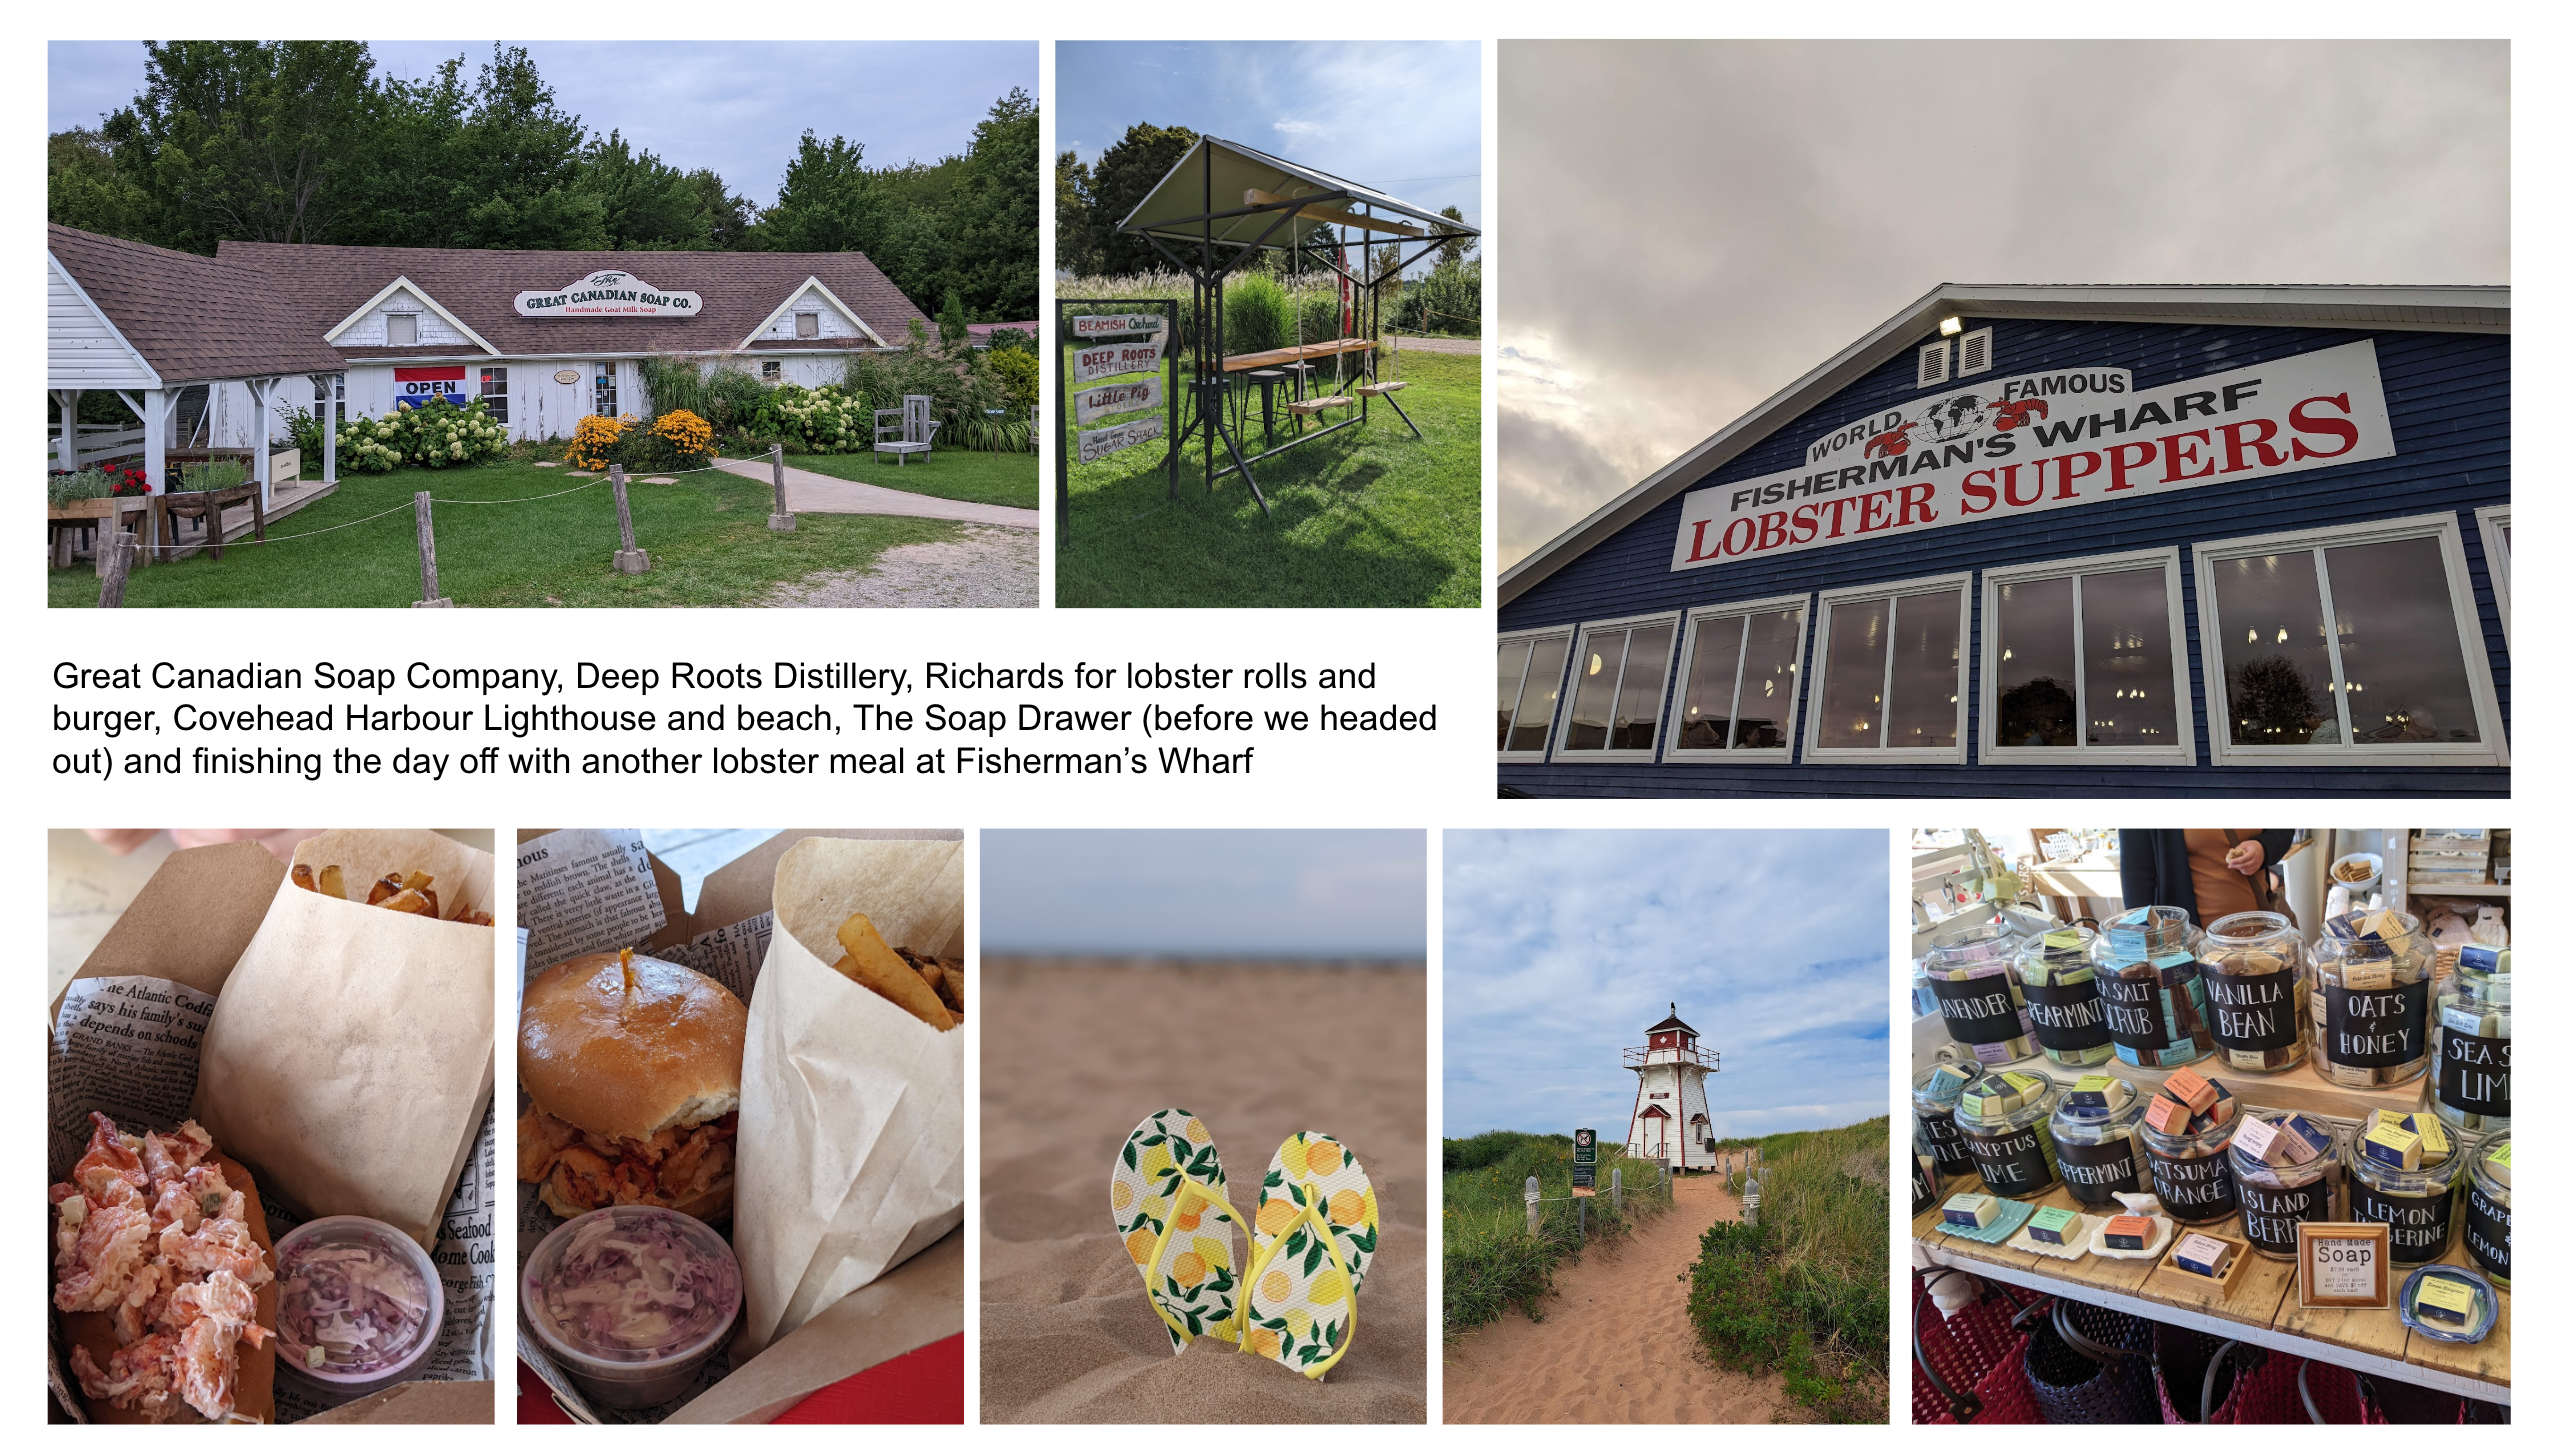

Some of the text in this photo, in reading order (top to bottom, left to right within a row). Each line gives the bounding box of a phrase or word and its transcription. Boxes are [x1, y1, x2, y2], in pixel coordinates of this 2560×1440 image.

[591, 273, 625, 287] The
[526, 289, 692, 309] GREAT CANADIAN SOAP CO.
[639, 306, 657, 314] Soap
[1078, 317, 1160, 332] BEAMISH Orchard
[1082, 348, 1156, 367] DEEP ROOTS
[1088, 359, 1150, 376] DISTILLERY
[405, 381, 456, 395] OPEN
[1089, 385, 1150, 409] Little Pig
[1811, 373, 2127, 463] WORLD FAMOUS
[1083, 426, 1159, 461] SUGAR SHACK
[1731, 378, 2263, 513] FISHERMAN'S WHARF
[1685, 391, 2360, 564] LOBSTER SUPPERS
[530, 844, 626, 883] Maritimes famous usually
[534, 855, 630, 893] reddish brown. The shells
[567, 880, 585, 892] each
[586, 870, 612, 886] animal
[613, 868, 626, 877] has
[529, 880, 622, 916] called the quick claw, as
[530, 890, 624, 926] There little waste
[537, 895, 643, 935] ventral arteries appearance
[545, 932, 563, 943] The
[563, 920, 595, 936] stomach
[603, 914, 619, 924] that
[534, 920, 631, 958] considered people
[613, 930, 634, 942] white
[125, 984, 172, 1004] Atlantic
[1935, 993, 2012, 1020] LAVENDER
[2112, 982, 2150, 1003] SALT
[2206, 978, 2284, 1006] VANILLA
[2348, 993, 2406, 1018] OATS
[88, 1000, 116, 1016] says
[117, 1001, 138, 1019] his
[139, 1006, 185, 1028] family's
[2100, 998, 2153, 1035] SCRUB
[2218, 1008, 2276, 1039] BEAN
[72, 1032, 133, 1052] GRAND BANKS
[79, 1014, 198, 1050] depends on schools
[2340, 1028, 2411, 1056] HONEY
[2447, 1038, 2494, 1065] SEA
[2461, 1069, 2511, 1102] LIM
[1970, 1155, 2027, 1184] LIME
[2056, 1156, 2132, 1185] EPPERMINT
[2145, 1151, 2228, 1181] SATSUMA
[2153, 1175, 2227, 1205] ORANGE
[2238, 1184, 2310, 1214] ISLAND
[2366, 1196, 2436, 1225] LEMON
[2471, 1190, 2511, 1228] GRAPE
[447, 1212, 492, 1241] Seafood
[2318, 1238, 2371, 1247] Hand Made
[2318, 1246, 2372, 1266] Soap
[2467, 1222, 2509, 1266] LEMON
[468, 1274, 484, 1290] Fish
